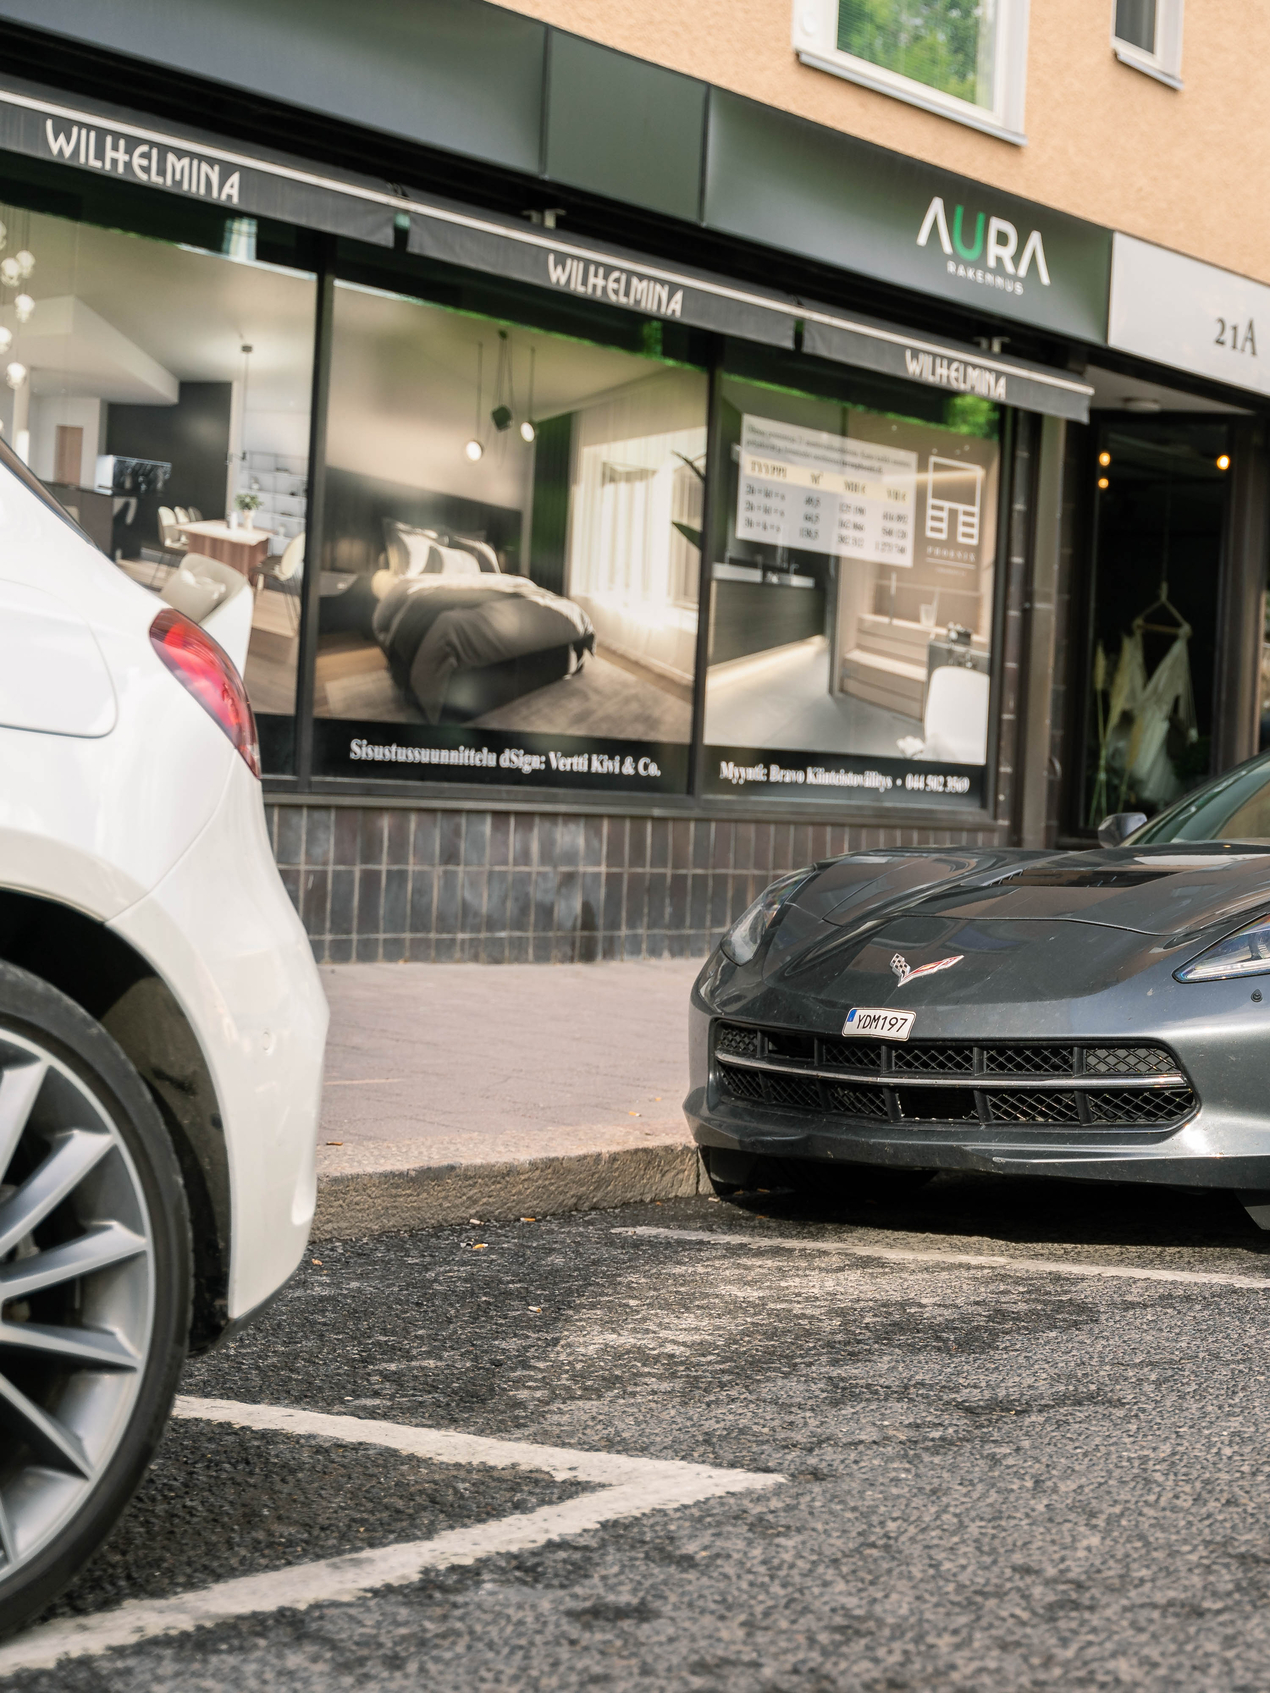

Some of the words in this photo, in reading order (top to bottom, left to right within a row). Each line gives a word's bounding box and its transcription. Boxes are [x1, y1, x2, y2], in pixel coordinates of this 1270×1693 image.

[45, 118, 240, 205] WILHELMINA
[916, 196, 1051, 287] AURA
[547, 252, 684, 319] WILHELMINA
[947, 260, 1024, 295] RAKENNUS
[1214, 317, 1257, 357] 21A
[905, 348, 1007, 401] WILHELMINA
[350, 738, 497, 768] Sisustussuunnittelu
[499, 748, 547, 774] dSign:
[548, 751, 589, 773] Vertti
[590, 754, 620, 775] Kivi
[621, 755, 636, 776] &
[637, 756, 661, 777] Co.
[769, 764, 805, 784] Bravo
[856, 1014, 908, 1033] YDM197
